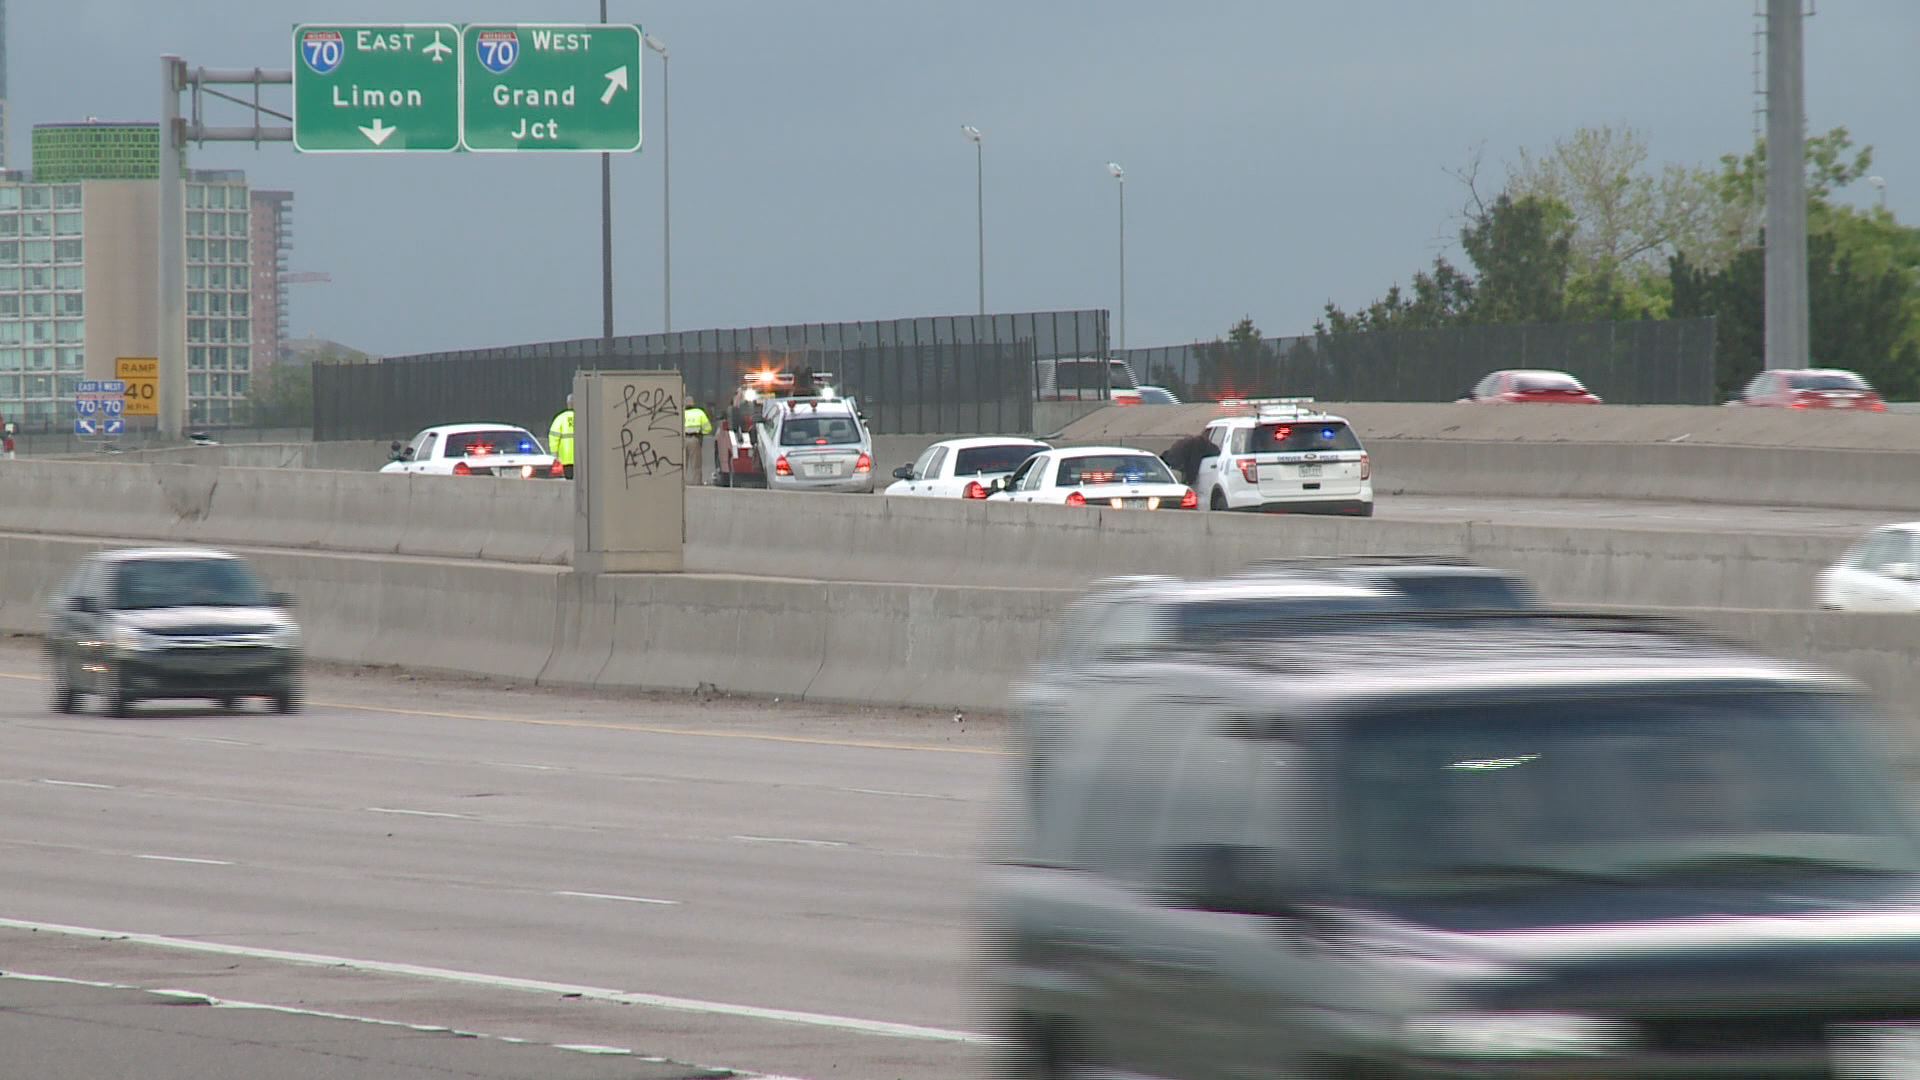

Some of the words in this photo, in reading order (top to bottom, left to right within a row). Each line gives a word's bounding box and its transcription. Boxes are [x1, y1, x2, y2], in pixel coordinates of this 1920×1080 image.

[356, 31, 415, 51] EAST
[532, 30, 592, 51] WEST
[306, 41, 339, 66] 70
[482, 41, 515, 66] 70
[332, 84, 422, 107] Limon
[493, 84, 576, 107] Grand
[511, 118, 559, 140] Jct
[121, 363, 156, 373] RAMP
[78, 383, 96, 392] EAST
[103, 383, 121, 392] WEST
[124, 383, 154, 400] 40
[78, 400, 96, 413] 70
[103, 400, 121, 413] 70
